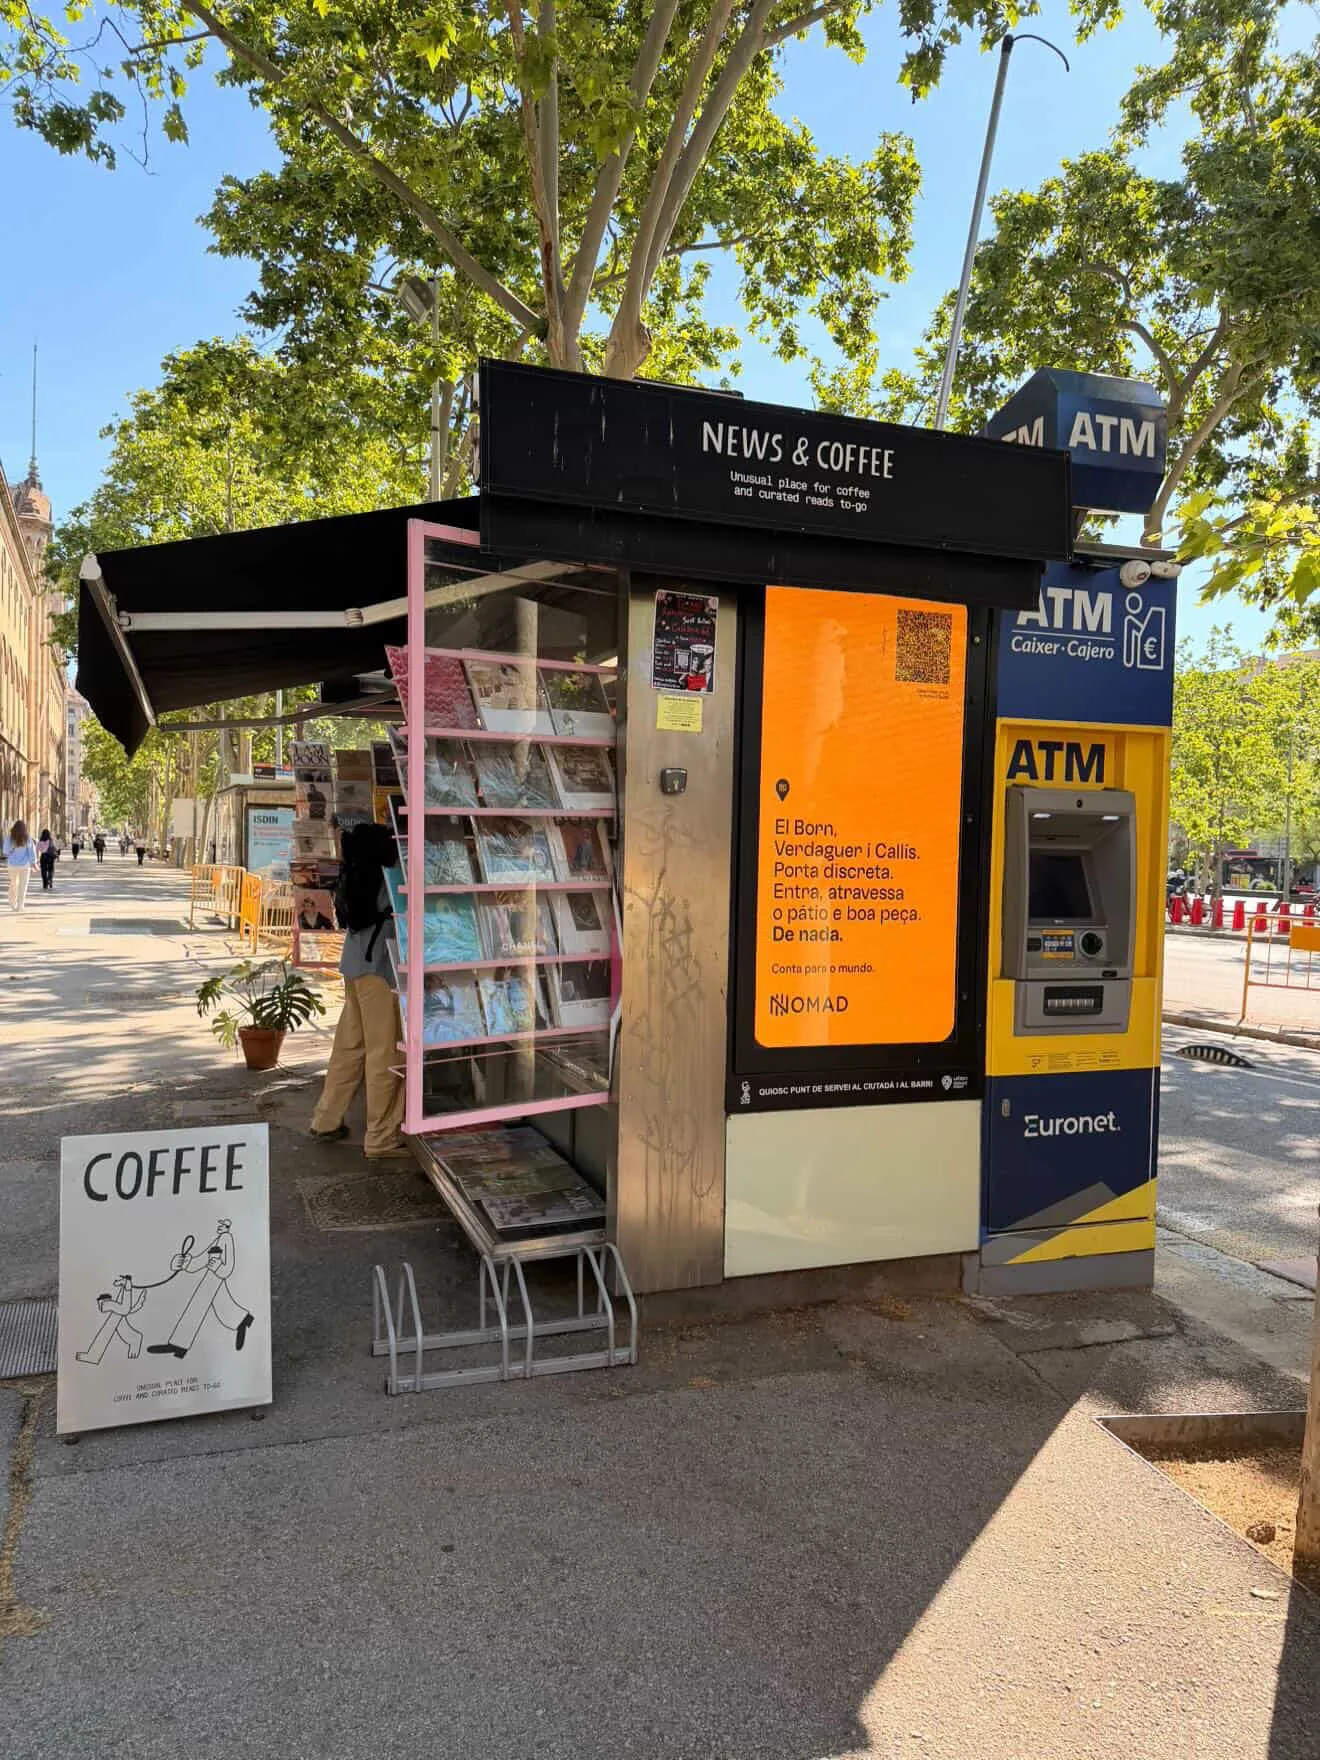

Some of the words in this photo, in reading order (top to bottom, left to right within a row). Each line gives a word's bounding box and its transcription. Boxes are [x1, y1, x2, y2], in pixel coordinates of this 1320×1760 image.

[1068, 411, 1155, 458] ATM
[702, 421, 783, 462] NEWS
[792, 437, 809, 467] &
[816, 441, 895, 479] COFFEE
[730, 471, 773, 486] Unusual
[778, 478, 808, 491] place
[813, 482, 831, 493] for
[836, 485, 870, 499] coffee
[734, 485, 753, 497] and
[758, 490, 800, 503] curated
[805, 496, 834, 508] reads
[840, 500, 868, 512] to-go
[1016, 586, 1113, 633] ATM
[1006, 739, 1106, 783] ATM
[775, 818, 789, 835] El
[794, 819, 838, 838] Born,
[774, 840, 862, 861] Verdaguer
[774, 862, 819, 878] Porta
[823, 864, 894, 880] discreta.
[773, 883, 823, 901] Entra,
[828, 884, 905, 900] atravessa
[773, 908, 783, 921] o
[787, 904, 828, 924] pátio
[833, 908, 842, 921] e
[847, 905, 876, 921] boa
[880, 907, 922, 926] peça.
[772, 926, 794, 942] De
[799, 926, 843, 942] nada.
[771, 963, 802, 974] Conta
[804, 964, 827, 976] para
[829, 965, 836, 973] o
[759, 1087, 789, 1096] QUIOSC
[790, 1085, 811, 1094] PUNT
[812, 1085, 823, 1093] DE
[824, 1083, 851, 1092] SERVEI
[852, 1082, 862, 1091] AL
[900, 1080, 909, 1088] AL
[910, 1080, 934, 1088] BARRI
[83, 1142, 247, 1202] COFFEE
